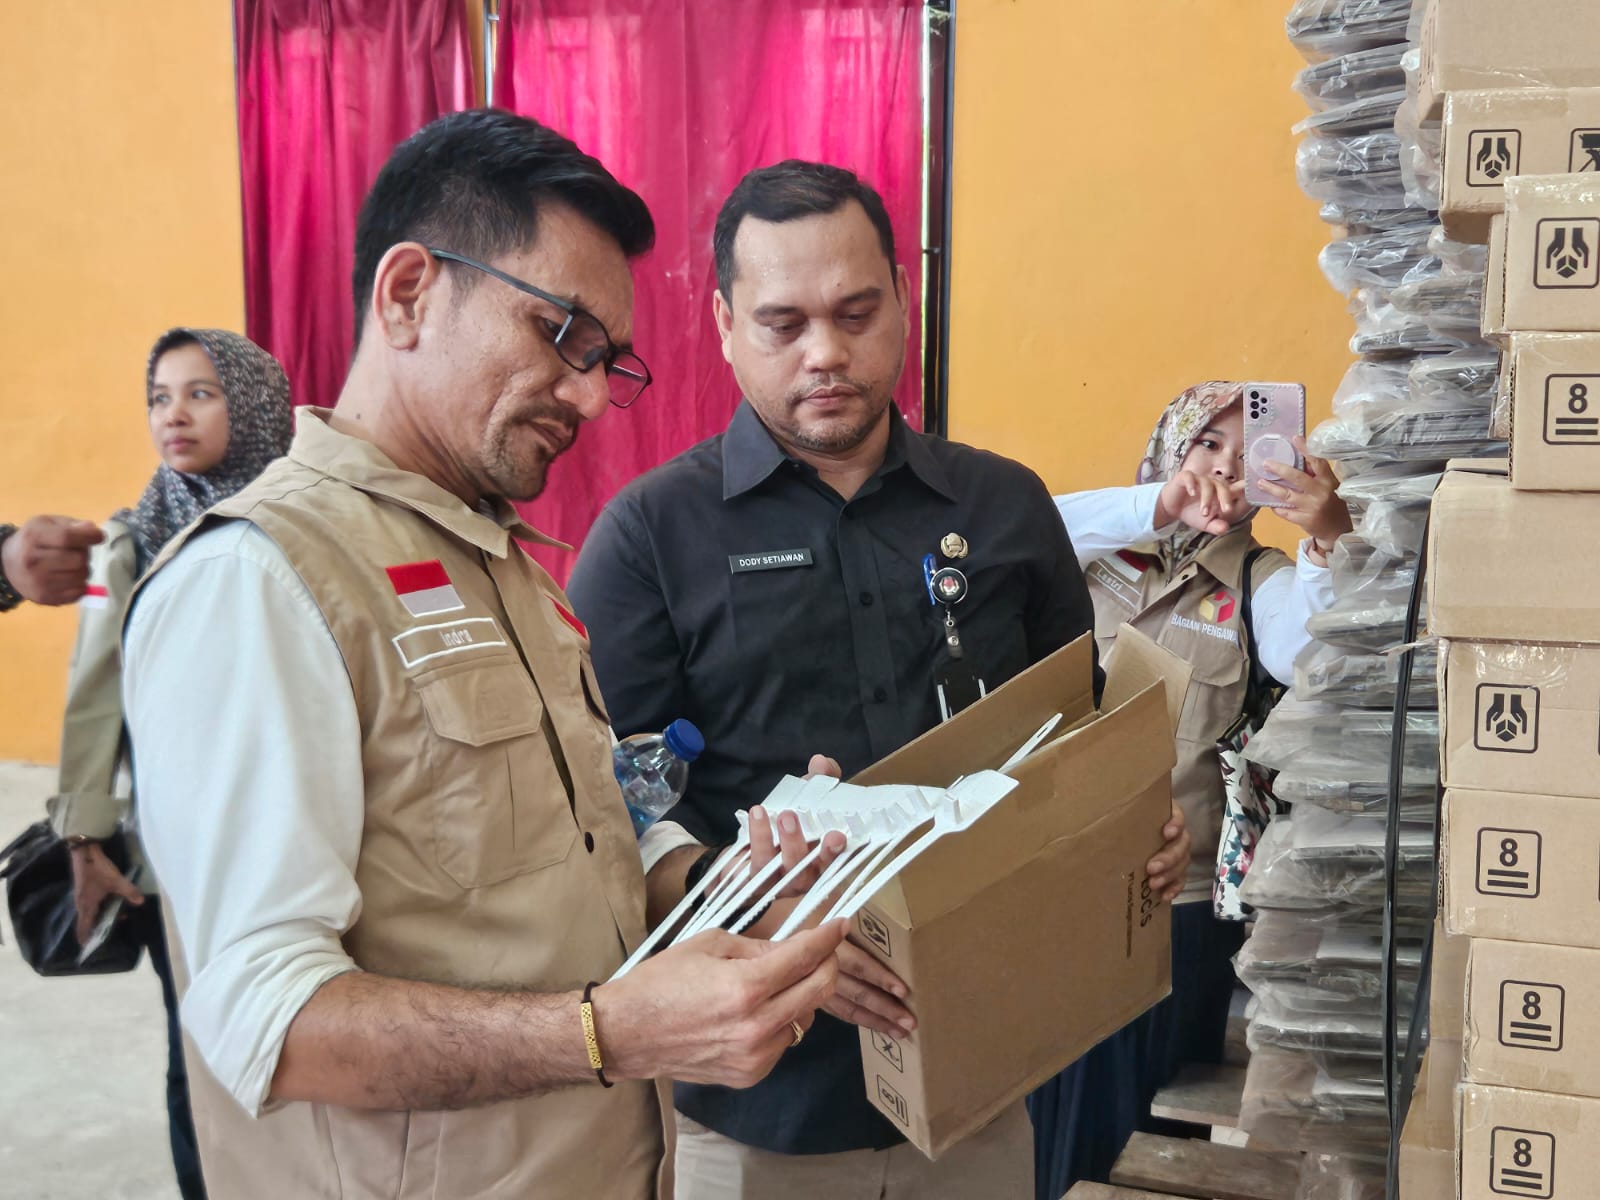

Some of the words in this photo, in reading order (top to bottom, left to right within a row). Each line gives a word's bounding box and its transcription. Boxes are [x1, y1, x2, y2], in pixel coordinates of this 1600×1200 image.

[1568, 383, 1588, 414] 8
[739, 557, 760, 567] DODY
[762, 553, 804, 564] SETIAWAN
[1171, 613, 1200, 631] BAGIAN
[1499, 838, 1518, 867] 8
[1522, 991, 1541, 1020] 8
[882, 1088, 895, 1105] 8
[1513, 1138, 1532, 1167] 8
